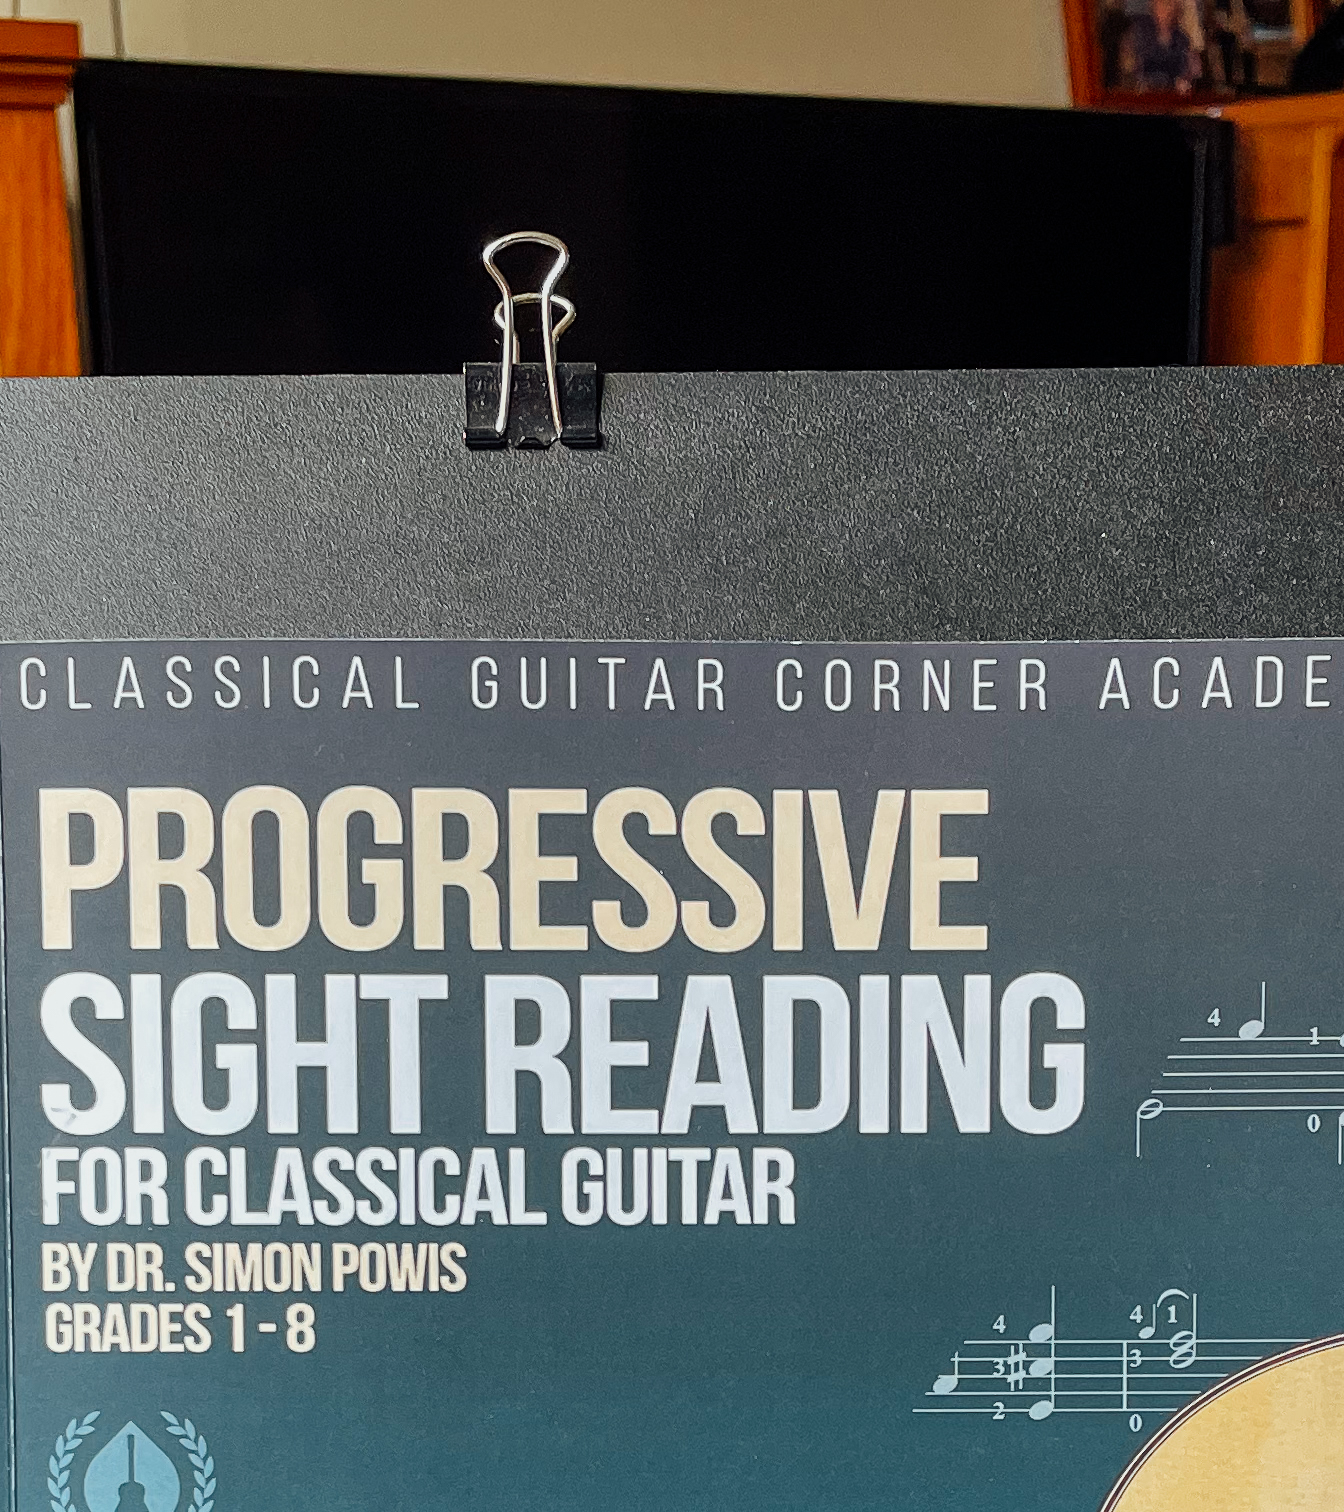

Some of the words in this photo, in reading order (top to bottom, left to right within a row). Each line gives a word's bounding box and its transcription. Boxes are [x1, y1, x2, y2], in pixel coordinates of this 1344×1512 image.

[20, 655, 420, 711] CLASSICAL
[472, 656, 727, 712] GUITAR
[775, 657, 1049, 713] CORNER
[37, 784, 990, 954] PROGRESSIVE
[1207, 1007, 1221, 1026] 4
[1309, 1026, 1320, 1045] 1
[39, 972, 450, 1137] SIGHT
[484, 972, 1087, 1136] READING
[1307, 1113, 1321, 1133] 0
[40, 1147, 167, 1226] FOR
[184, 1147, 547, 1226] CLASSICAL
[561, 1147, 797, 1227] GUITAR
[40, 1242, 93, 1293] BY
[106, 1243, 176, 1293] DR.
[185, 1242, 321, 1294] SIMON
[332, 1242, 468, 1294] POWIS
[992, 1314, 1006, 1334] 4
[1129, 1304, 1143, 1324] 4
[1167, 1304, 1178, 1324] 1
[45, 1303, 212, 1353] GRADES
[226, 1303, 246, 1353] 1
[285, 1303, 317, 1353] 8
[1129, 1349, 1142, 1368] 3
[992, 1401, 1005, 1420] 2
[1129, 1414, 1143, 1432] 0
